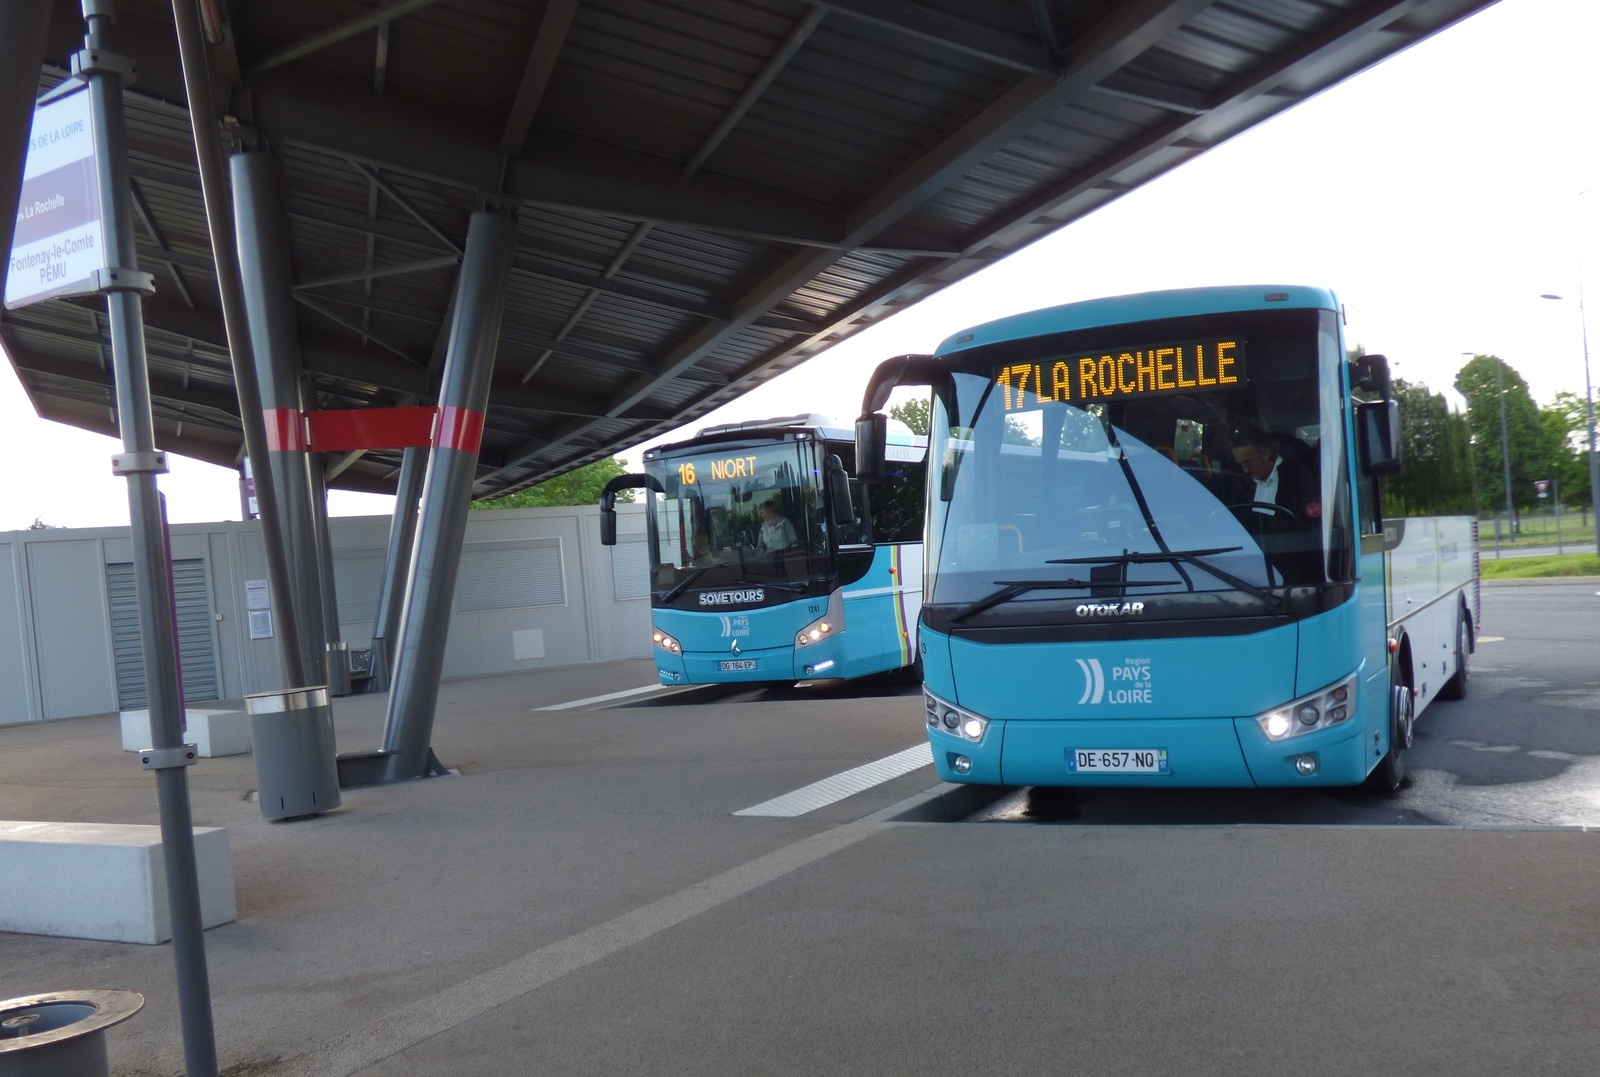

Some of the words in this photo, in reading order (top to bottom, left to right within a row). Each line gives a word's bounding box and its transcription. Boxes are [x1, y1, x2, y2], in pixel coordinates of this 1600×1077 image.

[38, 132, 50, 149] DE
[50, 126, 61, 144] LA
[61, 119, 85, 139] LOIRE
[25, 205, 34, 219] La
[35, 194, 65, 215] Rochelle
[10, 233, 94, 273] Fontenay-le-Comte
[997, 363, 1032, 410] 17
[1034, 361, 1071, 404] LA
[1079, 341, 1238, 398] ROCHELLE
[678, 462, 696, 485] 16
[710, 456, 757, 481] NIORT
[699, 588, 765, 606] SOVETOURS
[808, 604, 820, 614] 1241
[1076, 601, 1145, 618] OTOKAR
[733, 618, 749, 627] PAYS
[732, 628, 750, 637] LOIRE
[1112, 666, 1152, 681] PAYS
[1134, 681, 1144, 689] de
[1145, 681, 1152, 689] la
[1108, 689, 1153, 704] LOIRE
